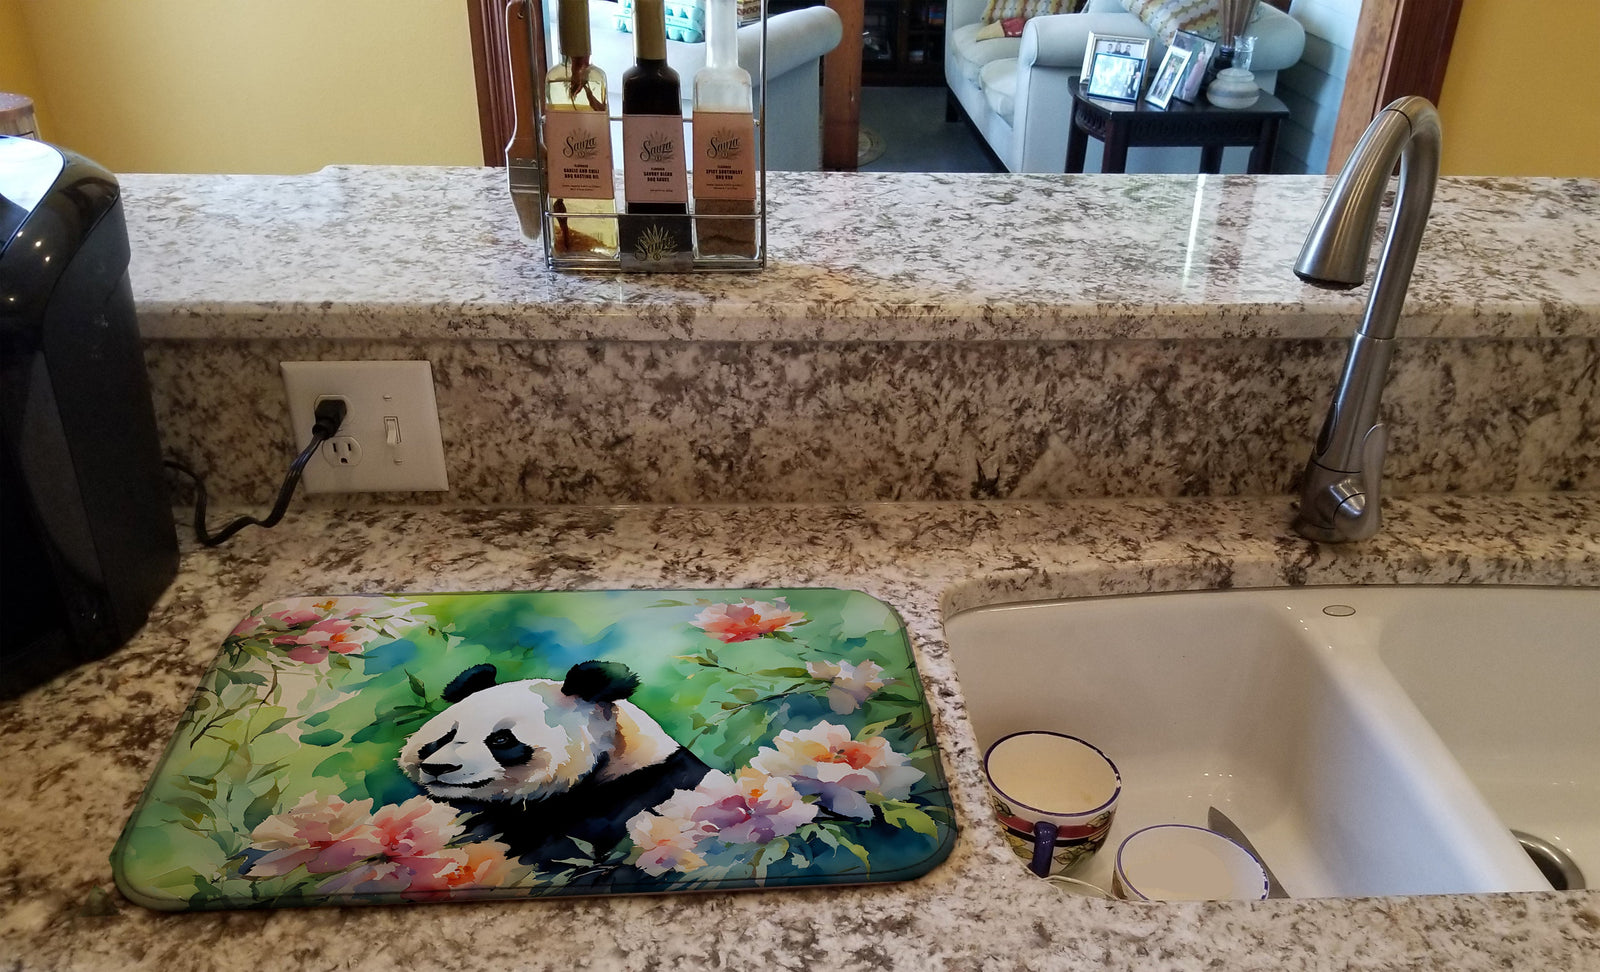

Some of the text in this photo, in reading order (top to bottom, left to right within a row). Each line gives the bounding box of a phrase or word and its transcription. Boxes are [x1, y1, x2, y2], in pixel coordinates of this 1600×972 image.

[563, 136, 597, 158] Sauza
[640, 140, 673, 161] Sauza
[707, 137, 740, 159] Sauza
